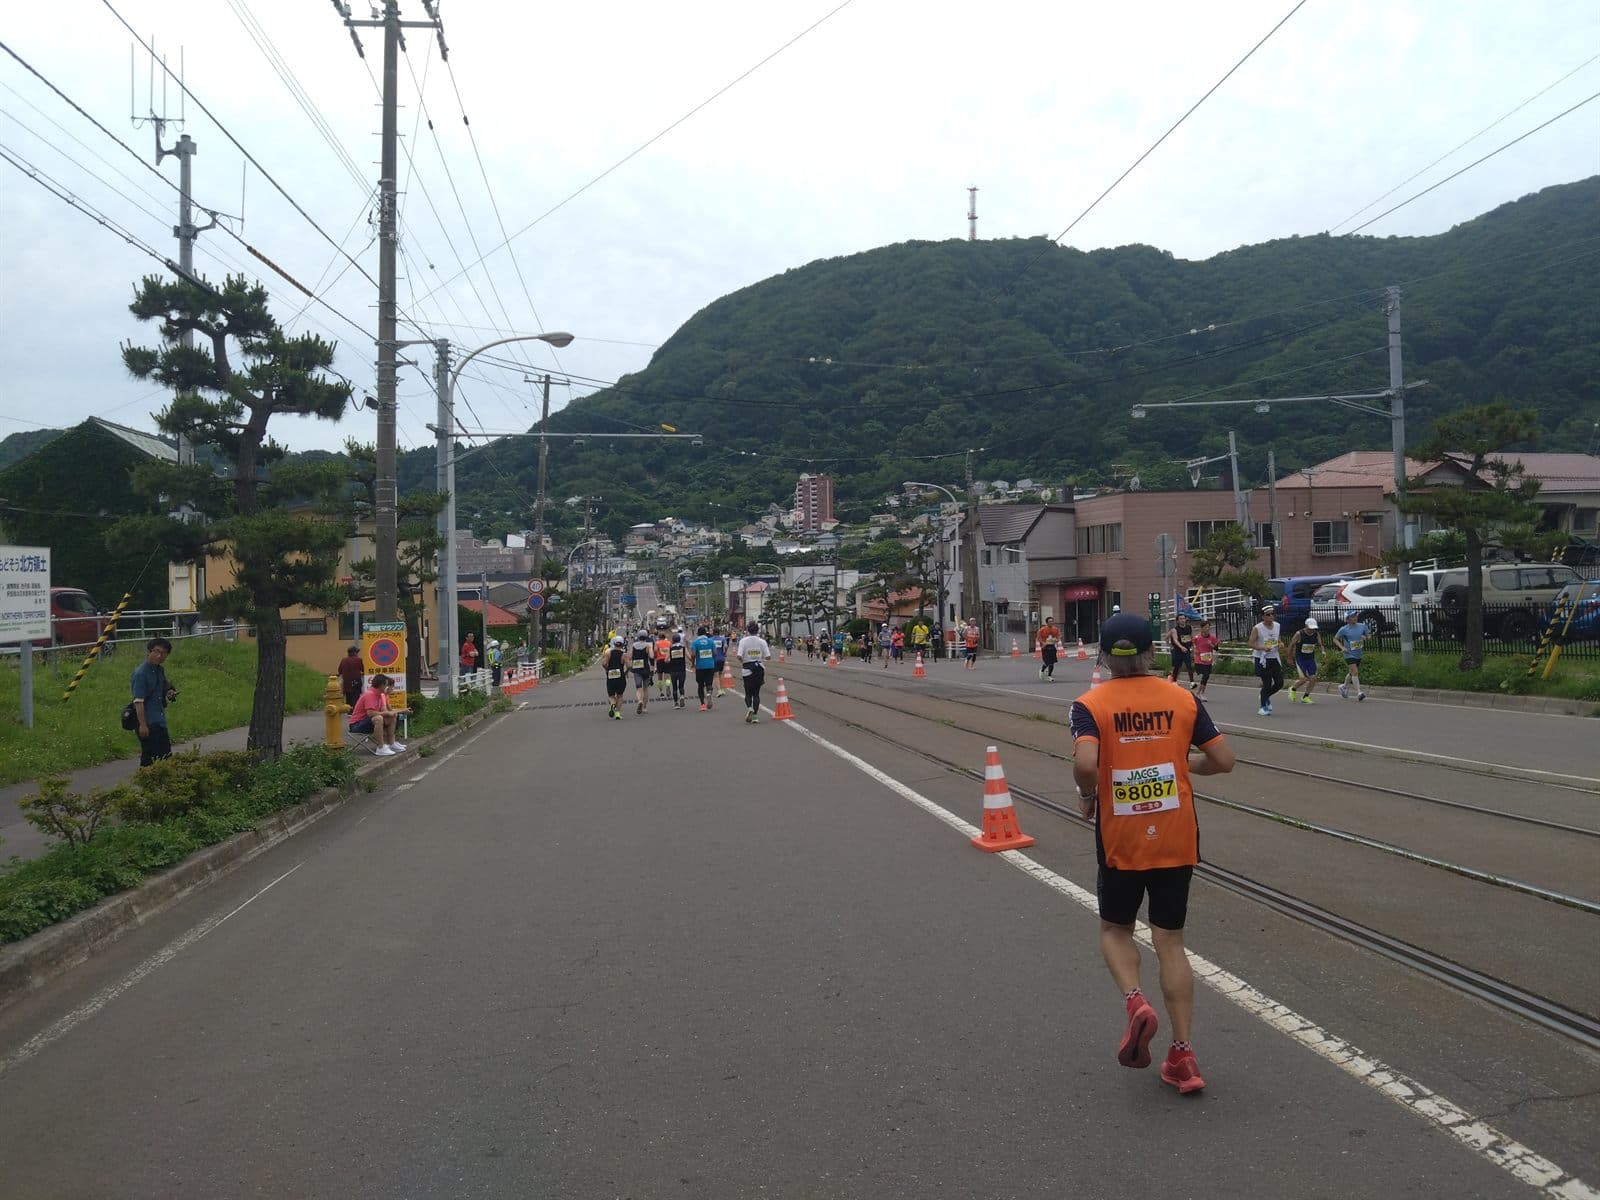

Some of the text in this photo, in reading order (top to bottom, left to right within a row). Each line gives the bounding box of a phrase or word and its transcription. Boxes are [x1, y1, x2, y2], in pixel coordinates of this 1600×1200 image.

[531, 582, 541, 590] 40
[1113, 710, 1174, 733] MIGHTY
[1127, 767, 1159, 780] JACCS
